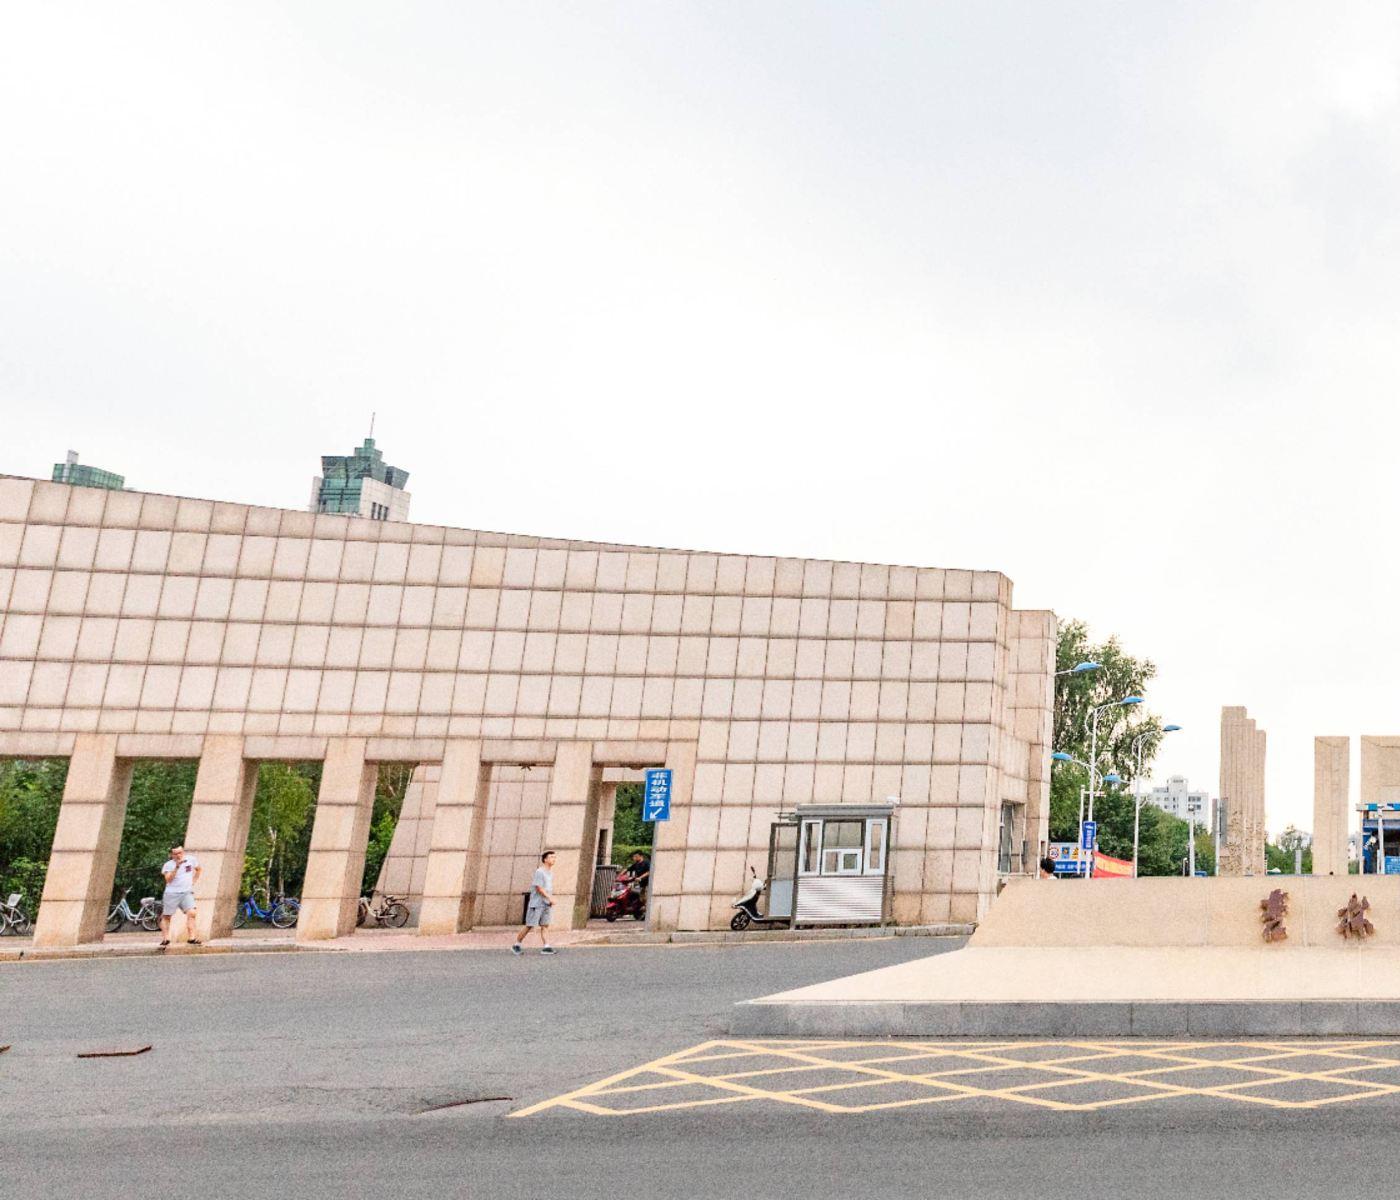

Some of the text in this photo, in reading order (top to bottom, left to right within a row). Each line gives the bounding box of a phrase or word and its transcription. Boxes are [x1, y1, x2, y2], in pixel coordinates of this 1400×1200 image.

[649, 772, 668, 807] 非机动车道
